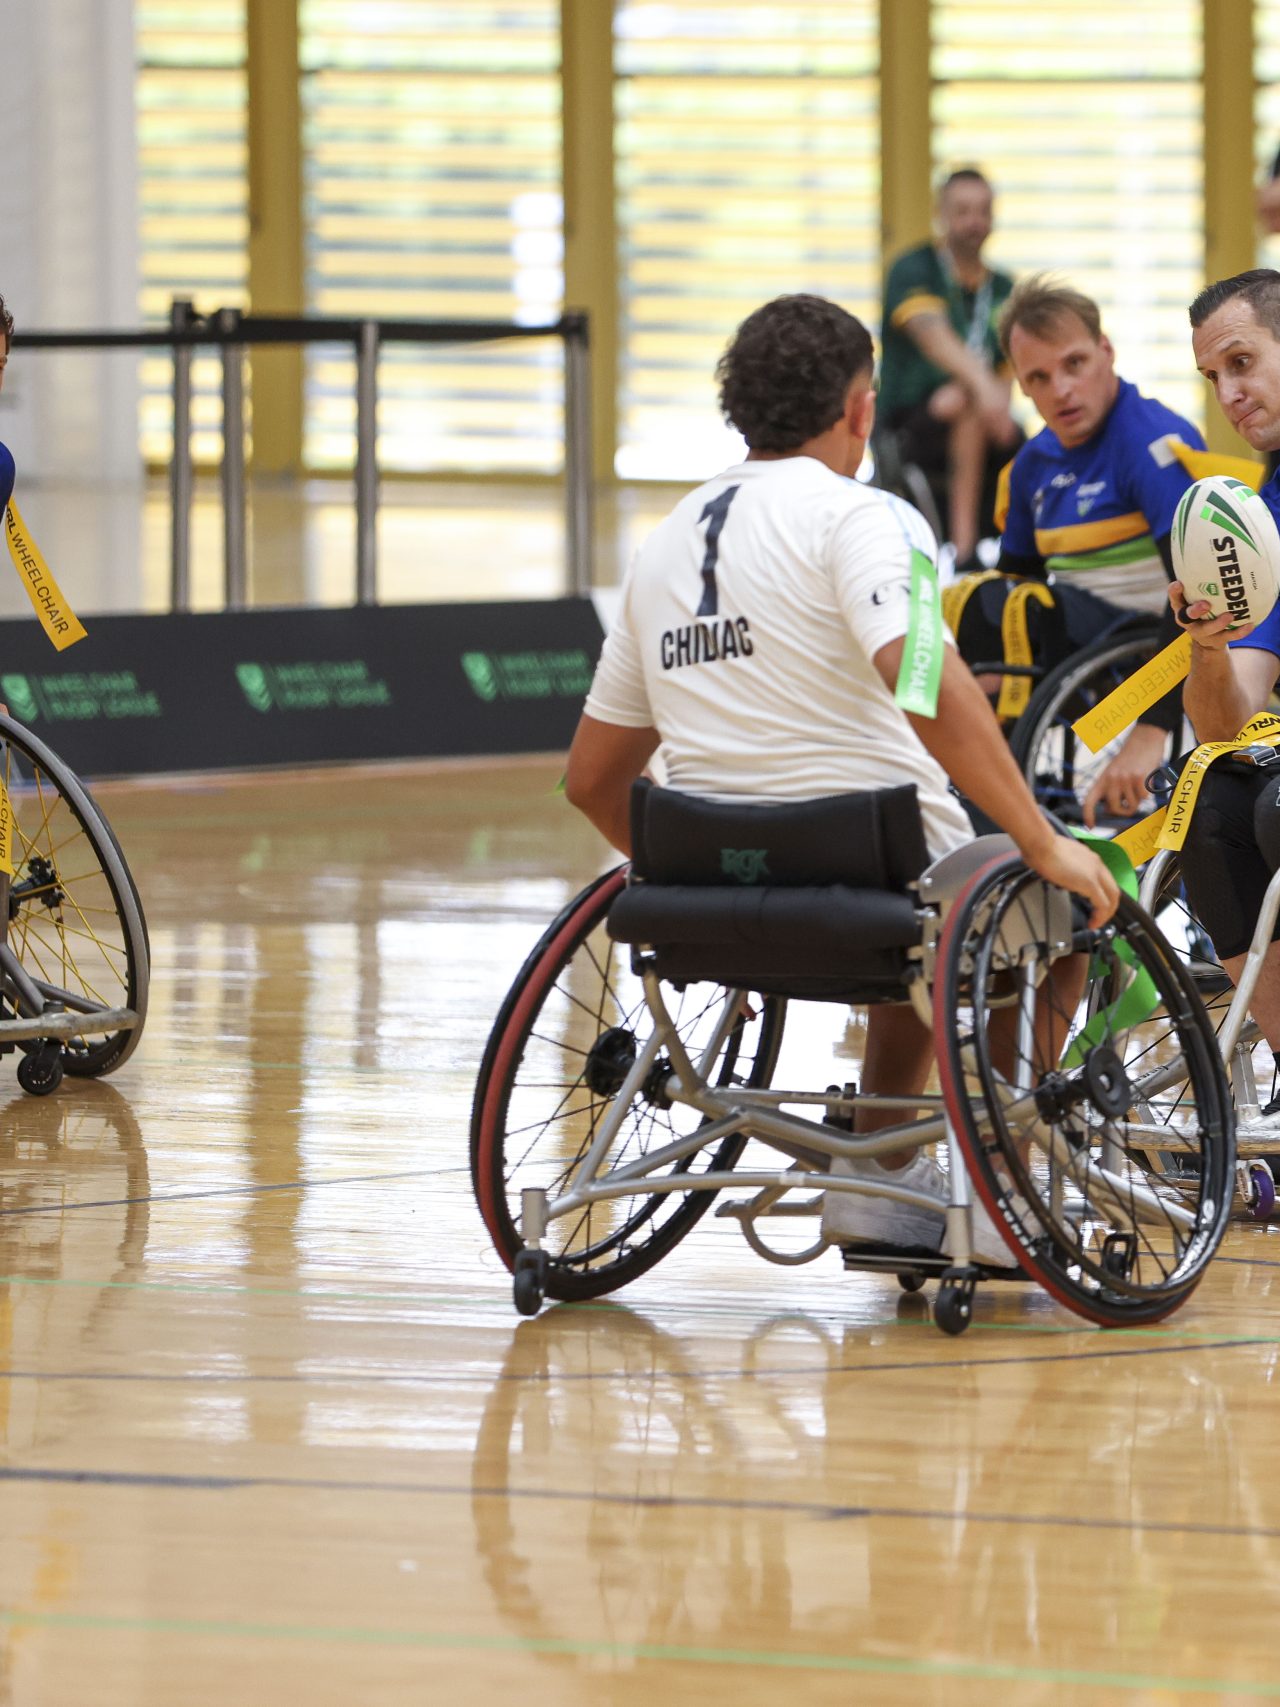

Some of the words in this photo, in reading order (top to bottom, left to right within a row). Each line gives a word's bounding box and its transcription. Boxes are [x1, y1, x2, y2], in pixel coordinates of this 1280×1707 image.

[11, 532, 69, 635] WHEELCHAIR
[696, 484, 742, 617] 1
[1212, 535, 1251, 622] STEEDEN
